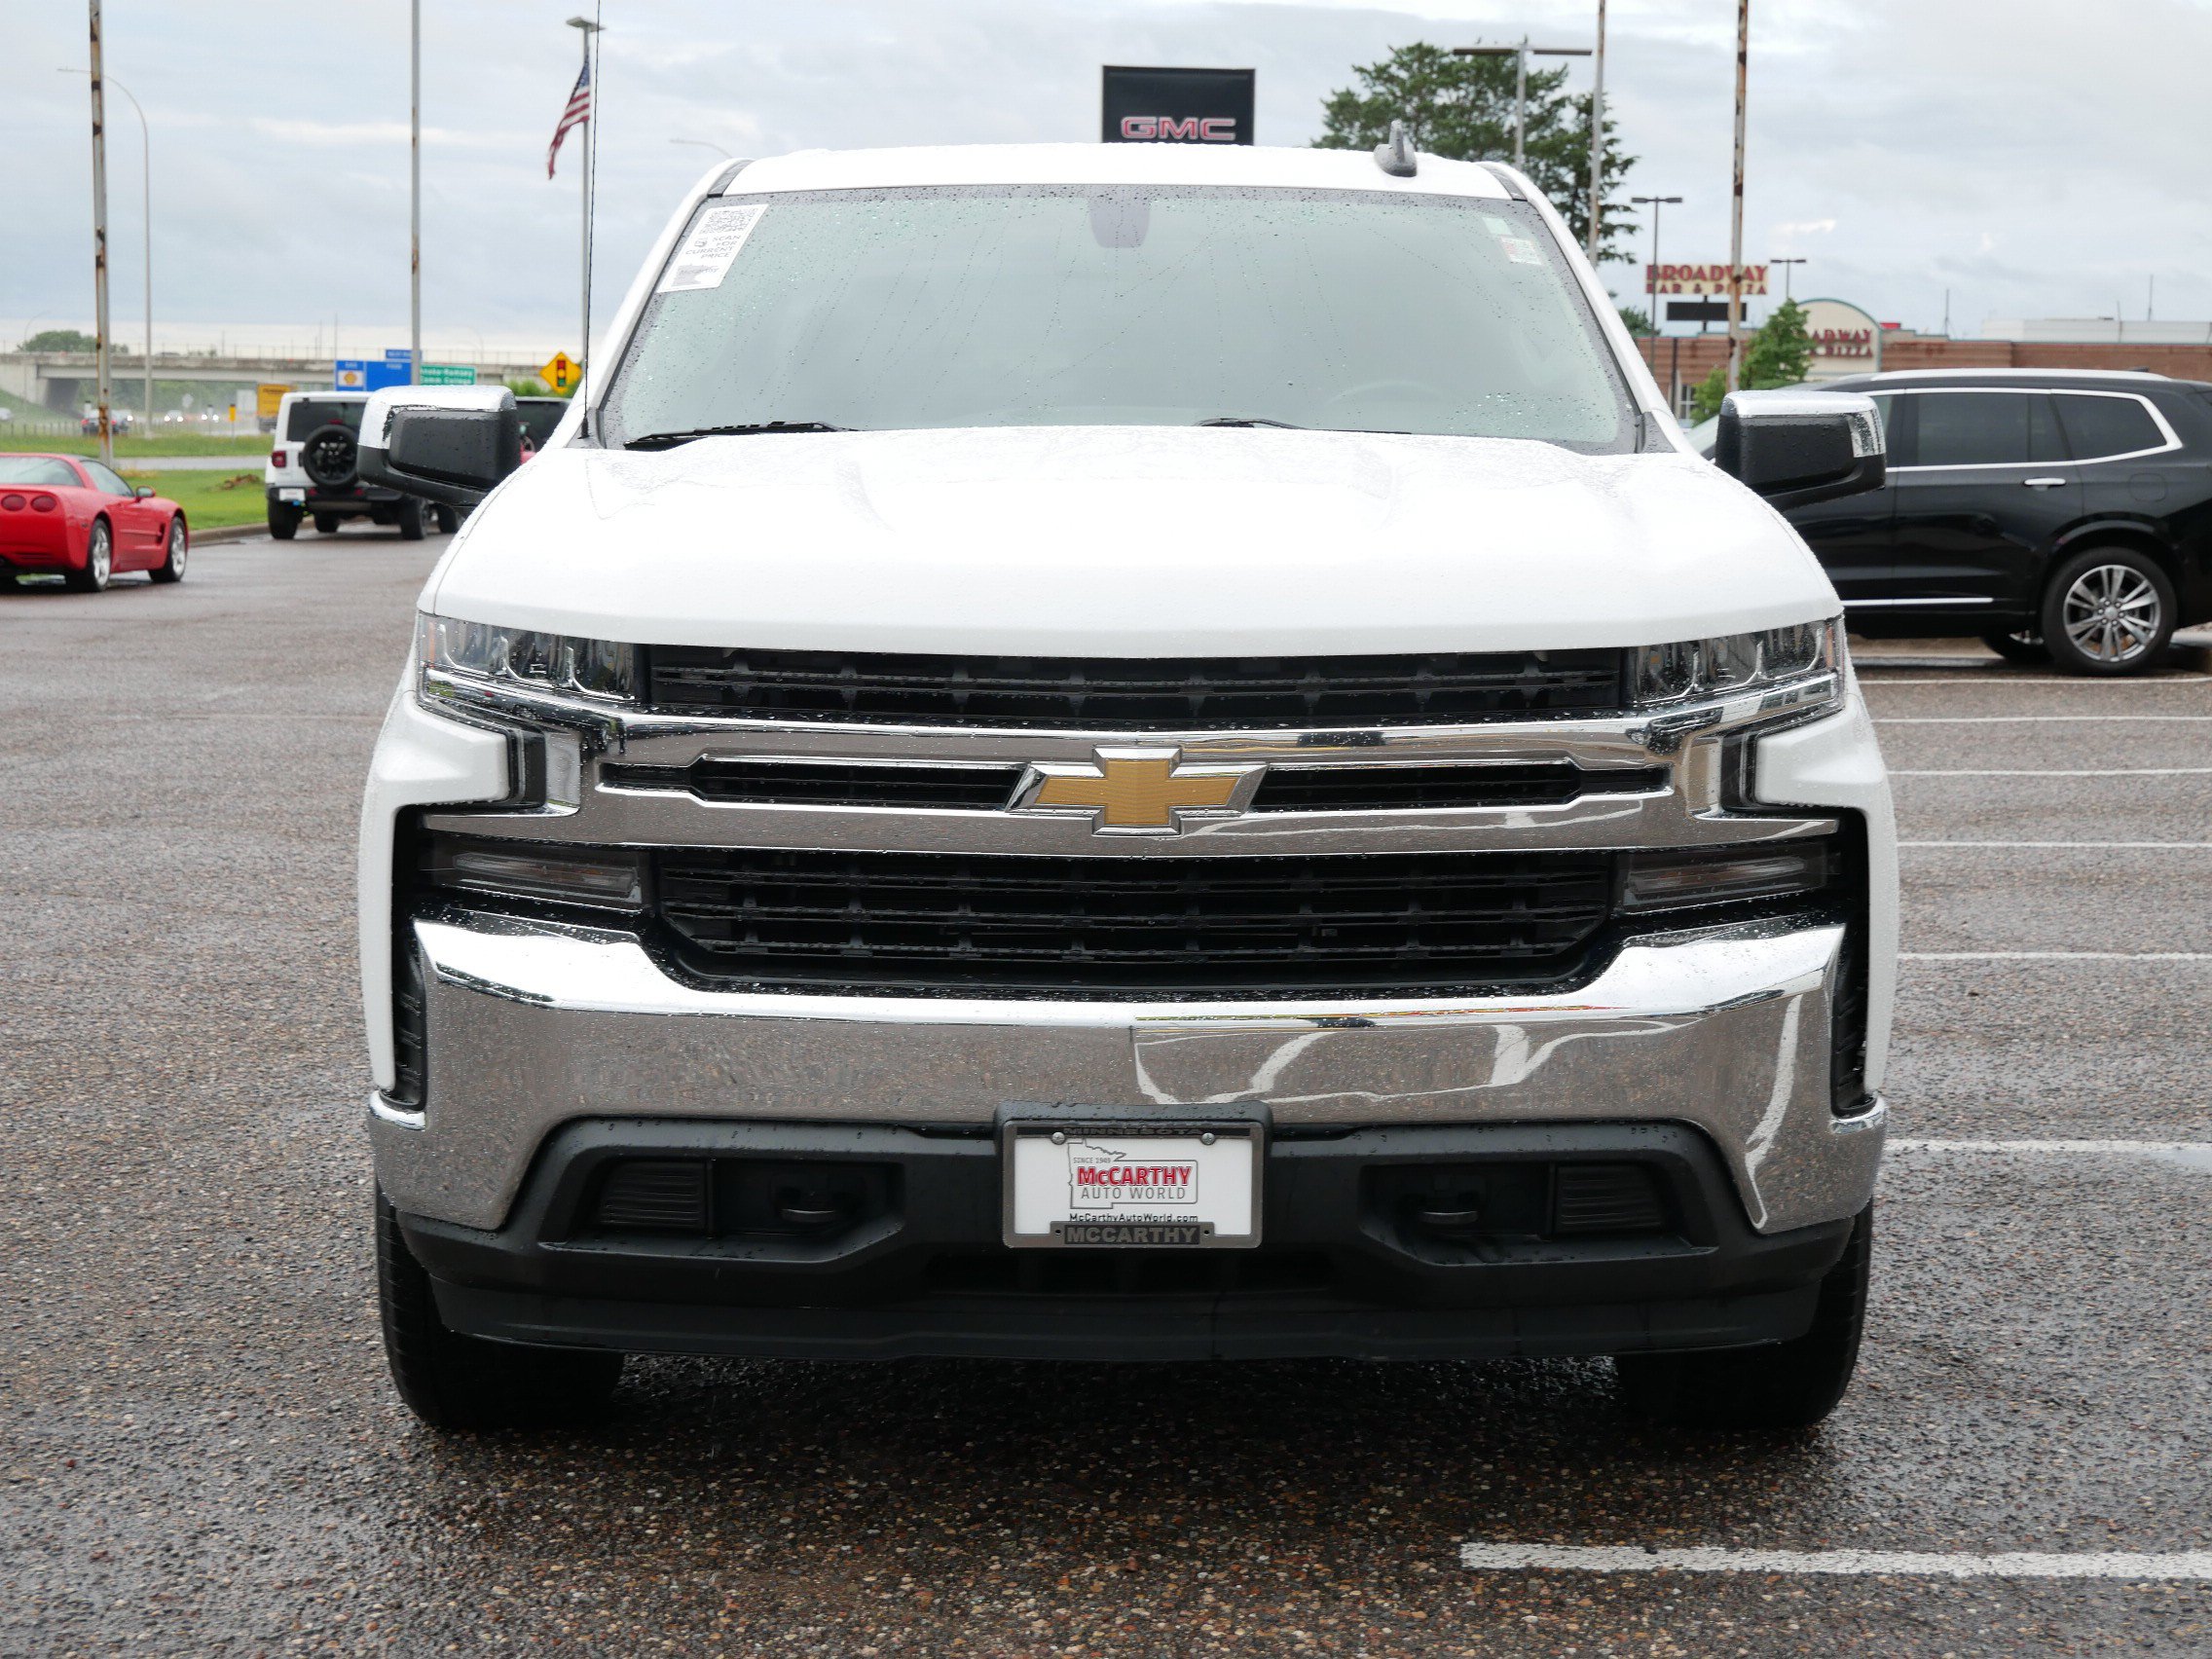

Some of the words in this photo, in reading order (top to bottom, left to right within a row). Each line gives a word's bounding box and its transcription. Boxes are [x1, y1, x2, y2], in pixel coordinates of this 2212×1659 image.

[1121, 116, 1236, 140] GMC
[685, 246, 733, 255] CURRENT
[1714, 283, 1767, 294] PZA
[1078, 1165, 1193, 1186] McCARTHY
[1081, 1187, 1122, 1199] AUTO
[1130, 1187, 1186, 1199] WORLD
[1069, 1213, 1198, 1223] McCarthyAutoWorld.com
[1067, 1227, 1197, 1243] MCCARTHY
